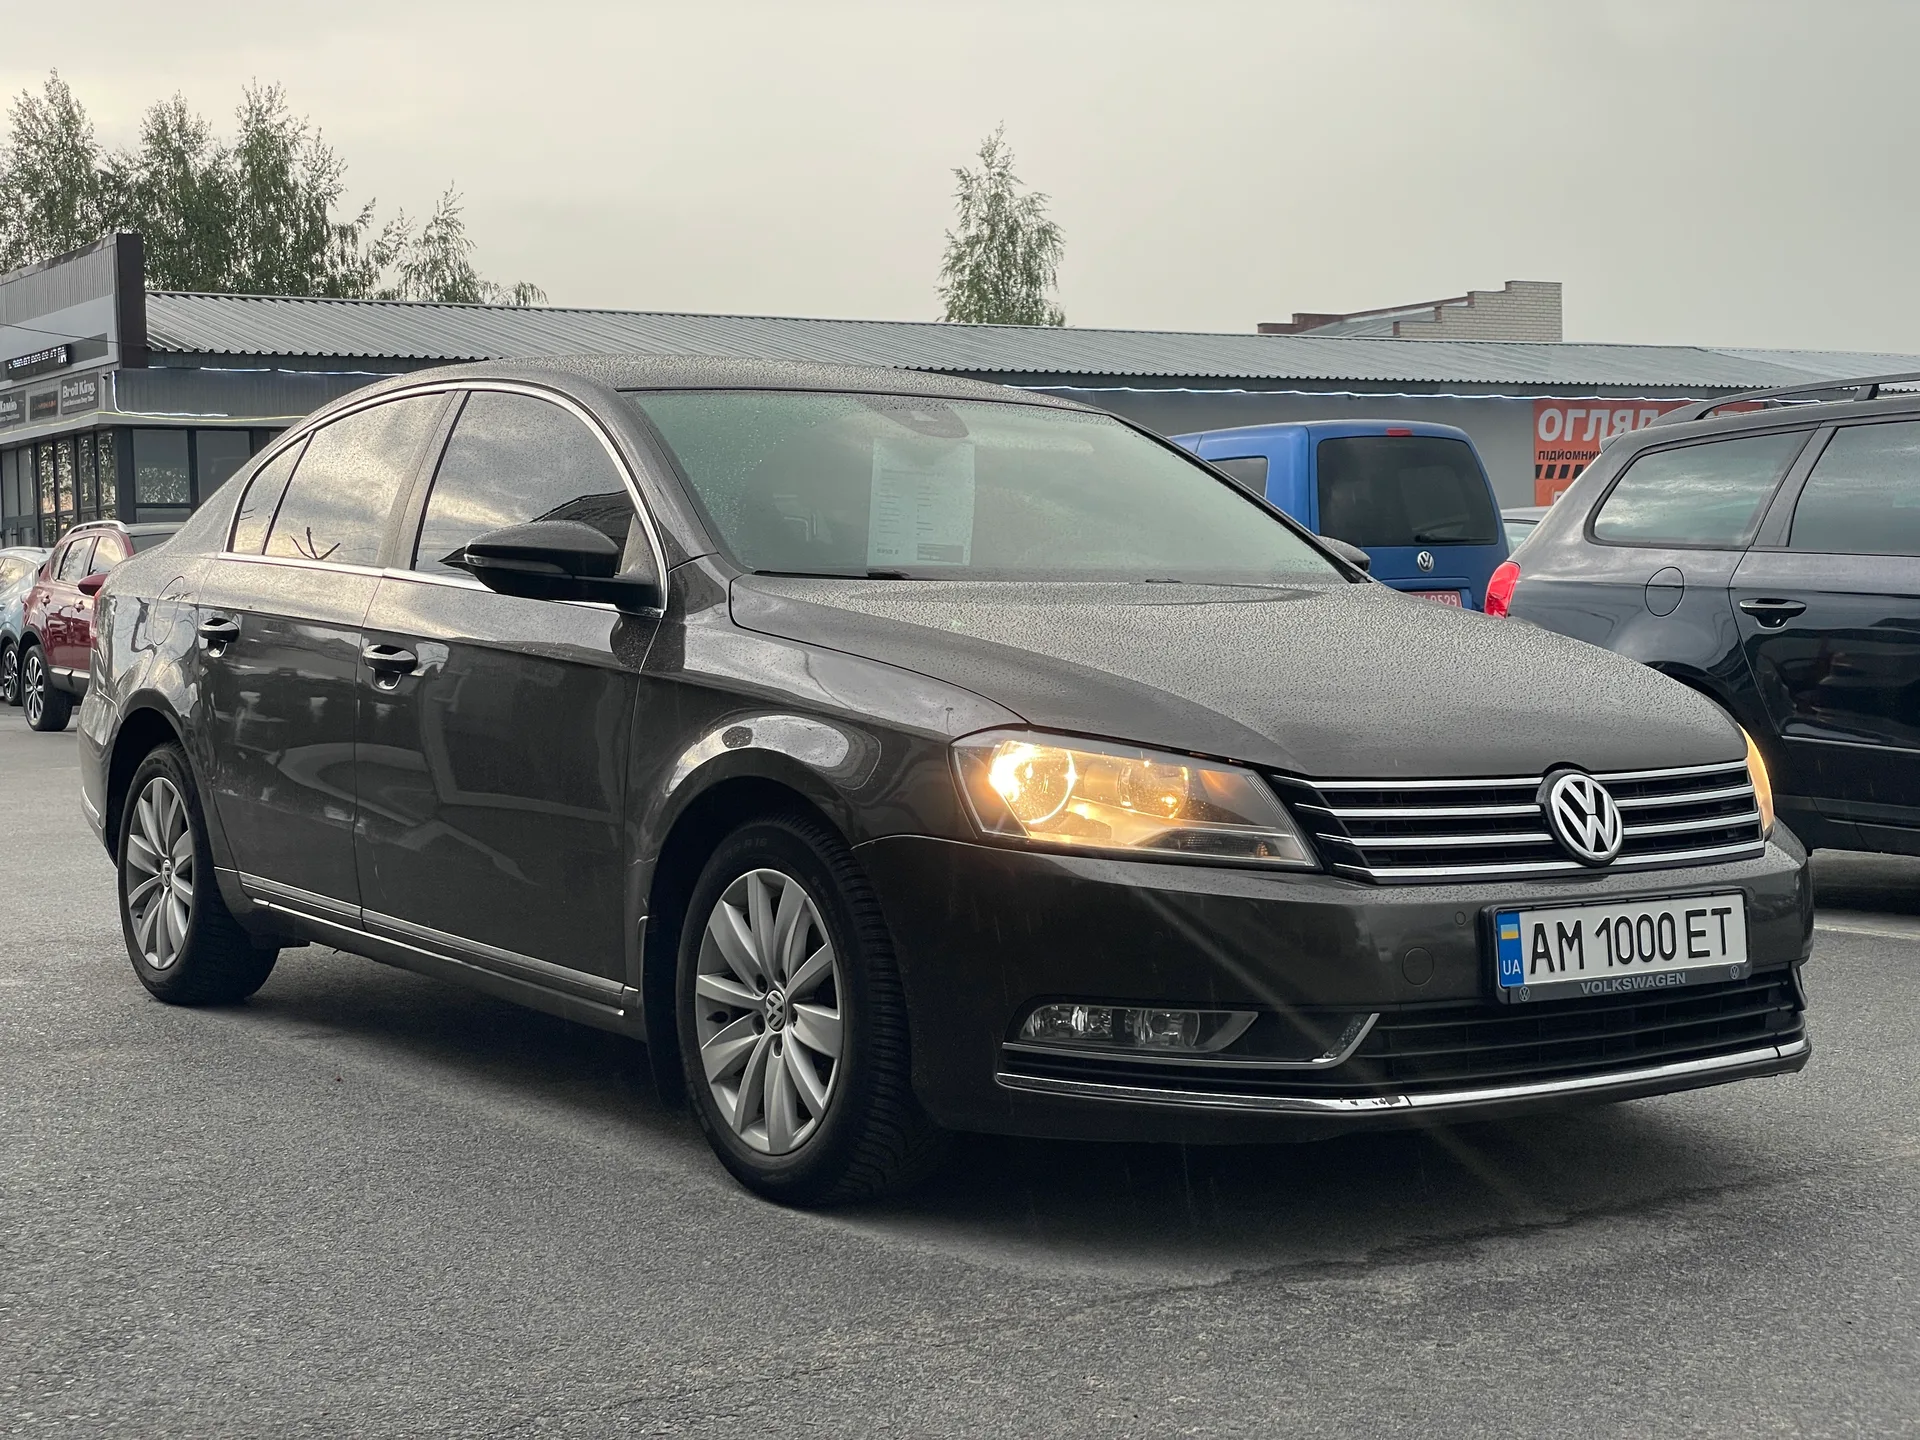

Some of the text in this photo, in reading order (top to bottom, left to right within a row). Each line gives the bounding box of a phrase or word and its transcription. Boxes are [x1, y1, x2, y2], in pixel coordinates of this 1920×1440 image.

[1530, 907, 1732, 975] AM 1000 ET
[1502, 959, 1522, 975] UA
[1580, 971, 1686, 995] VOLKSWAGEN
